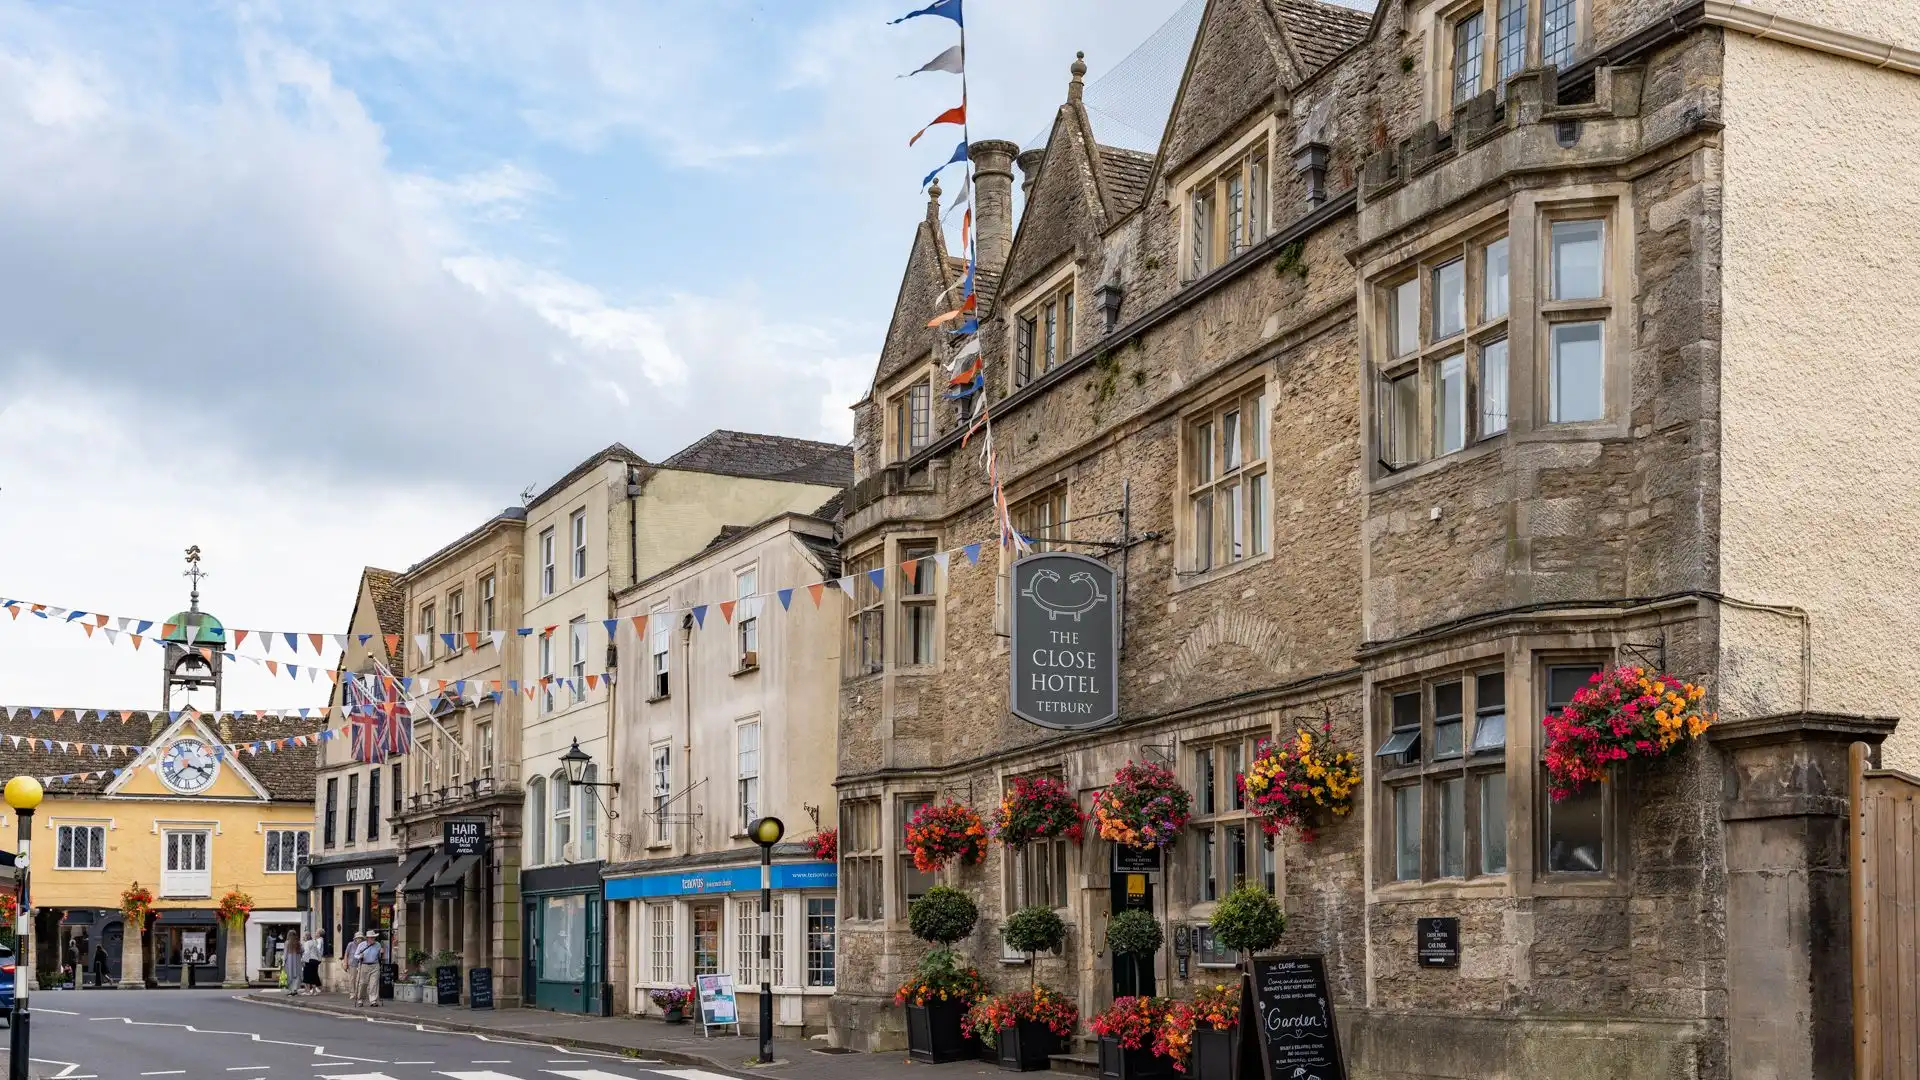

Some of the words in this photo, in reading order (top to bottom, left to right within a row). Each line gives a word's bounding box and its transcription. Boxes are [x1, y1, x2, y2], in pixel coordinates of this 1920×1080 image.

[1050, 630, 1079, 645] THE
[1032, 649, 1096, 670] CLOSE
[1031, 673, 1099, 694] HOTEL
[1036, 700, 1093, 714] TETBURY
[451, 823, 477, 835] HAIR
[449, 836, 480, 844] BEAUTY
[346, 867, 374, 882] OVERIDER
[682, 877, 704, 889] tenovus
[1278, 962, 1296, 970] CLOSE
[1268, 1008, 1321, 1030] Garden
